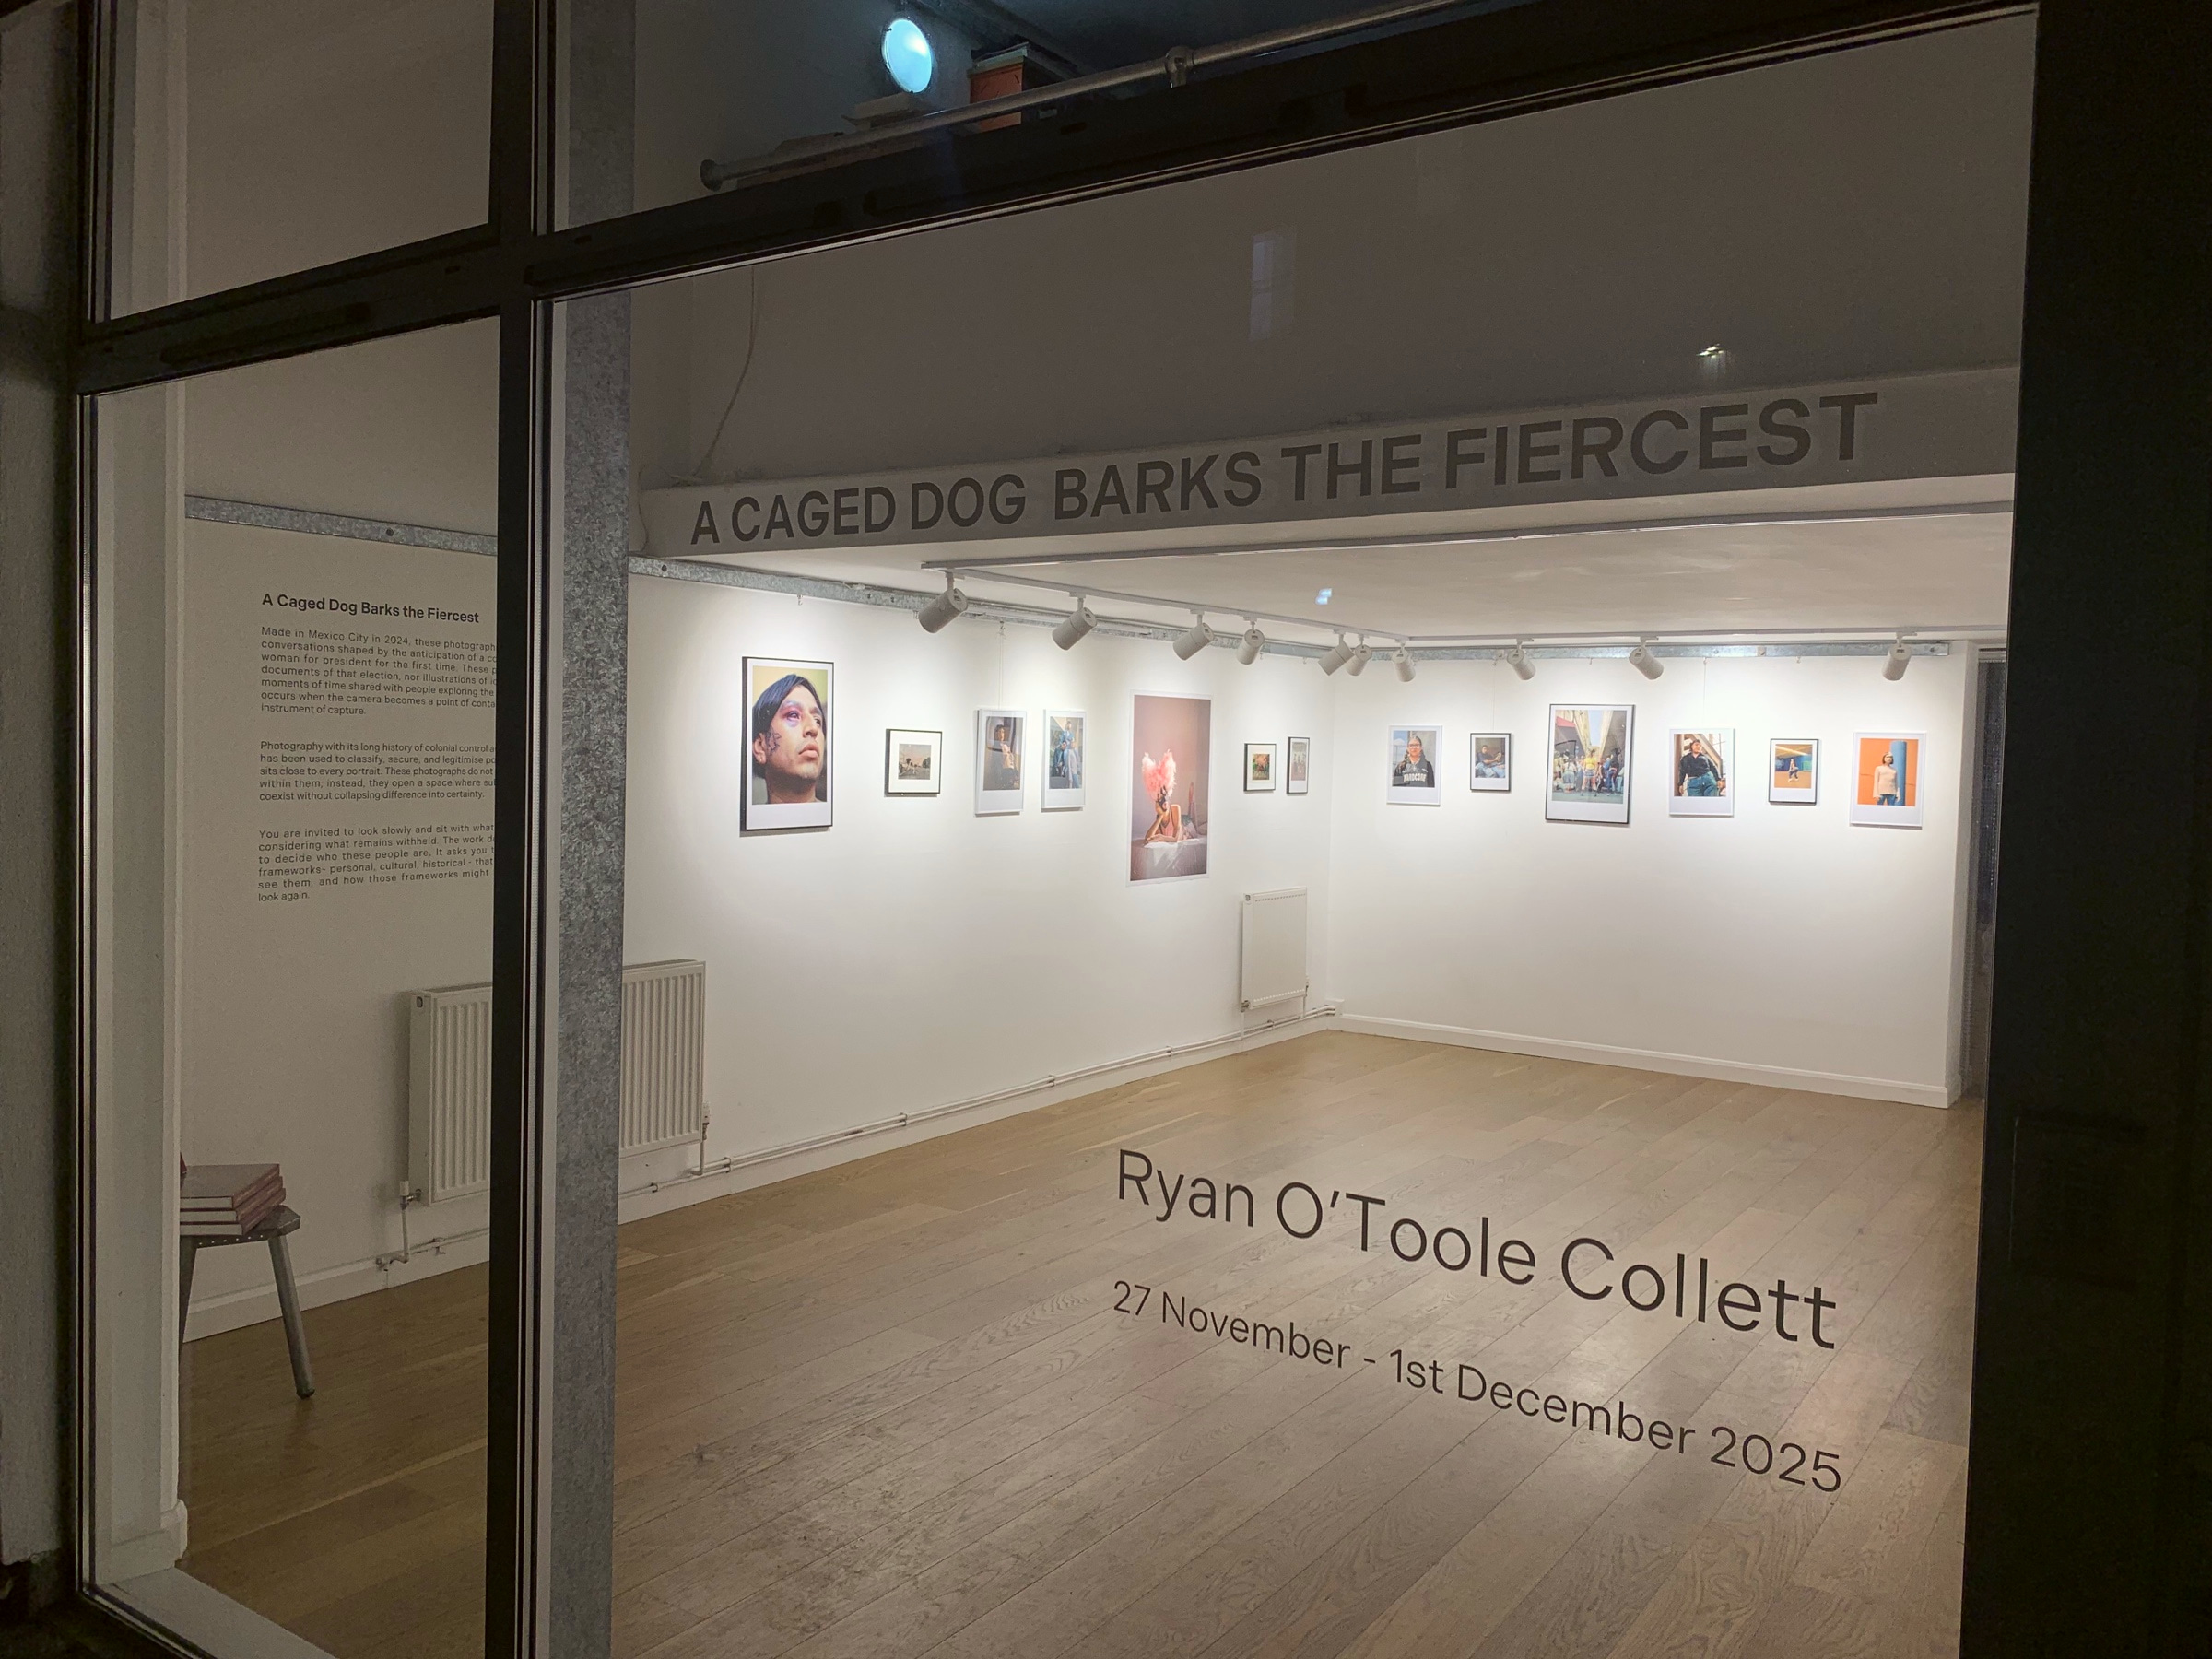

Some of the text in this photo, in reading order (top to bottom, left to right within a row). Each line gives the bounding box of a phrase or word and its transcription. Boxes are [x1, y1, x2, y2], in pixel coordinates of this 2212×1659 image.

[690, 392, 1878, 545] A CAGED DOG BARKS THE FIERCEST
[262, 594, 479, 624] A Caged Dog Barks the Fiercest
[261, 626, 291, 637] Made
[295, 627, 304, 638] in
[308, 629, 345, 641] Mexico
[348, 632, 369, 644] City
[371, 634, 381, 643] in
[415, 638, 441, 648] these
[443, 640, 496, 652] photograph
[261, 641, 335, 653] conversations
[337, 644, 374, 655] shaped
[377, 646, 388, 658] by
[392, 648, 406, 657] the
[410, 650, 465, 661] anticipation
[467, 653, 477, 661] of
[261, 653, 300, 663] woman
[304, 654, 319, 664] for
[323, 657, 371, 667] president
[375, 658, 389, 667] for
[393, 660, 408, 669] the
[412, 660, 431, 670] first
[462, 664, 488, 674] These
[261, 665, 320, 677] documents
[323, 667, 334, 677] of
[336, 668, 357, 678] that
[423, 673, 477, 685] illustrations
[478, 677, 488, 685] of
[261, 679, 494, 698] moments of time shared with people exploring the
[261, 692, 296, 700] occurs
[298, 691, 325, 701] when
[327, 692, 344, 702] the
[346, 695, 382, 703] camera
[384, 695, 426, 705] becomes
[436, 698, 458, 707] point
[460, 698, 469, 707] of
[261, 702, 314, 714] instrument
[316, 704, 326, 713] of
[260, 741, 324, 753] Photography
[324, 742, 346, 751] with
[347, 743, 359, 751] its
[360, 742, 381, 753] long
[382, 743, 413, 754] history
[414, 743, 423, 752] of
[425, 743, 458, 752] colonial
[459, 745, 488, 753] control
[260, 753, 278, 763] has
[281, 753, 306, 763] been
[309, 754, 333, 763] used
[335, 755, 346, 763] to
[423, 755, 441, 764] and
[442, 755, 484, 766] legitimise
[260, 767, 277, 775] sits
[279, 766, 305, 775] close
[307, 767, 318, 775] to
[319, 769, 344, 777] every
[384, 766, 411, 775] These
[413, 767, 466, 777] photographs
[467, 767, 478, 775] do
[259, 779, 291, 788] within
[369, 779, 389, 789] they
[392, 780, 415, 789] open
[426, 780, 453, 788] space
[454, 778, 481, 787] where
[259, 792, 294, 801] coexist
[296, 791, 333, 800] without
[334, 790, 381, 802] collapsing
[382, 790, 427, 799] difference
[259, 830, 279, 839] You
[304, 828, 340, 837] invited
[344, 828, 354, 836] to
[358, 827, 378, 836] look
[382, 825, 412, 836] slowly
[415, 825, 432, 834] and
[436, 825, 448, 833] sit
[450, 824, 469, 832] with
[473, 823, 494, 831] what
[258, 841, 322, 852] considering
[325, 840, 349, 849] what
[353, 838, 393, 848] remains
[442, 836, 460, 844] The
[462, 835, 484, 843] work
[258, 856, 270, 865] to
[275, 853, 312, 864] decide
[316, 853, 337, 862] who
[342, 852, 371, 861] these
[375, 849, 409, 861] people
[436, 848, 442, 856] It
[446, 847, 467, 856] asks
[470, 848, 487, 856] you
[423, 858, 465, 868] historical
[475, 857, 493, 865] that
[257, 881, 278, 889] see
[319, 876, 338, 886] and
[343, 876, 364, 885] how
[369, 874, 397, 883] those
[401, 871, 458, 881] frameworks
[462, 868, 488, 879] might
[258, 892, 279, 902] look
[1118, 1149, 1837, 1349] Ryan O'Toole Collett
[1112, 1280, 1151, 1317] 27
[1161, 1291, 1352, 1369] November
[1389, 1350, 1444, 1394] 1st
[1458, 1364, 1696, 1454] December
[1711, 1426, 1843, 1493] 2025
